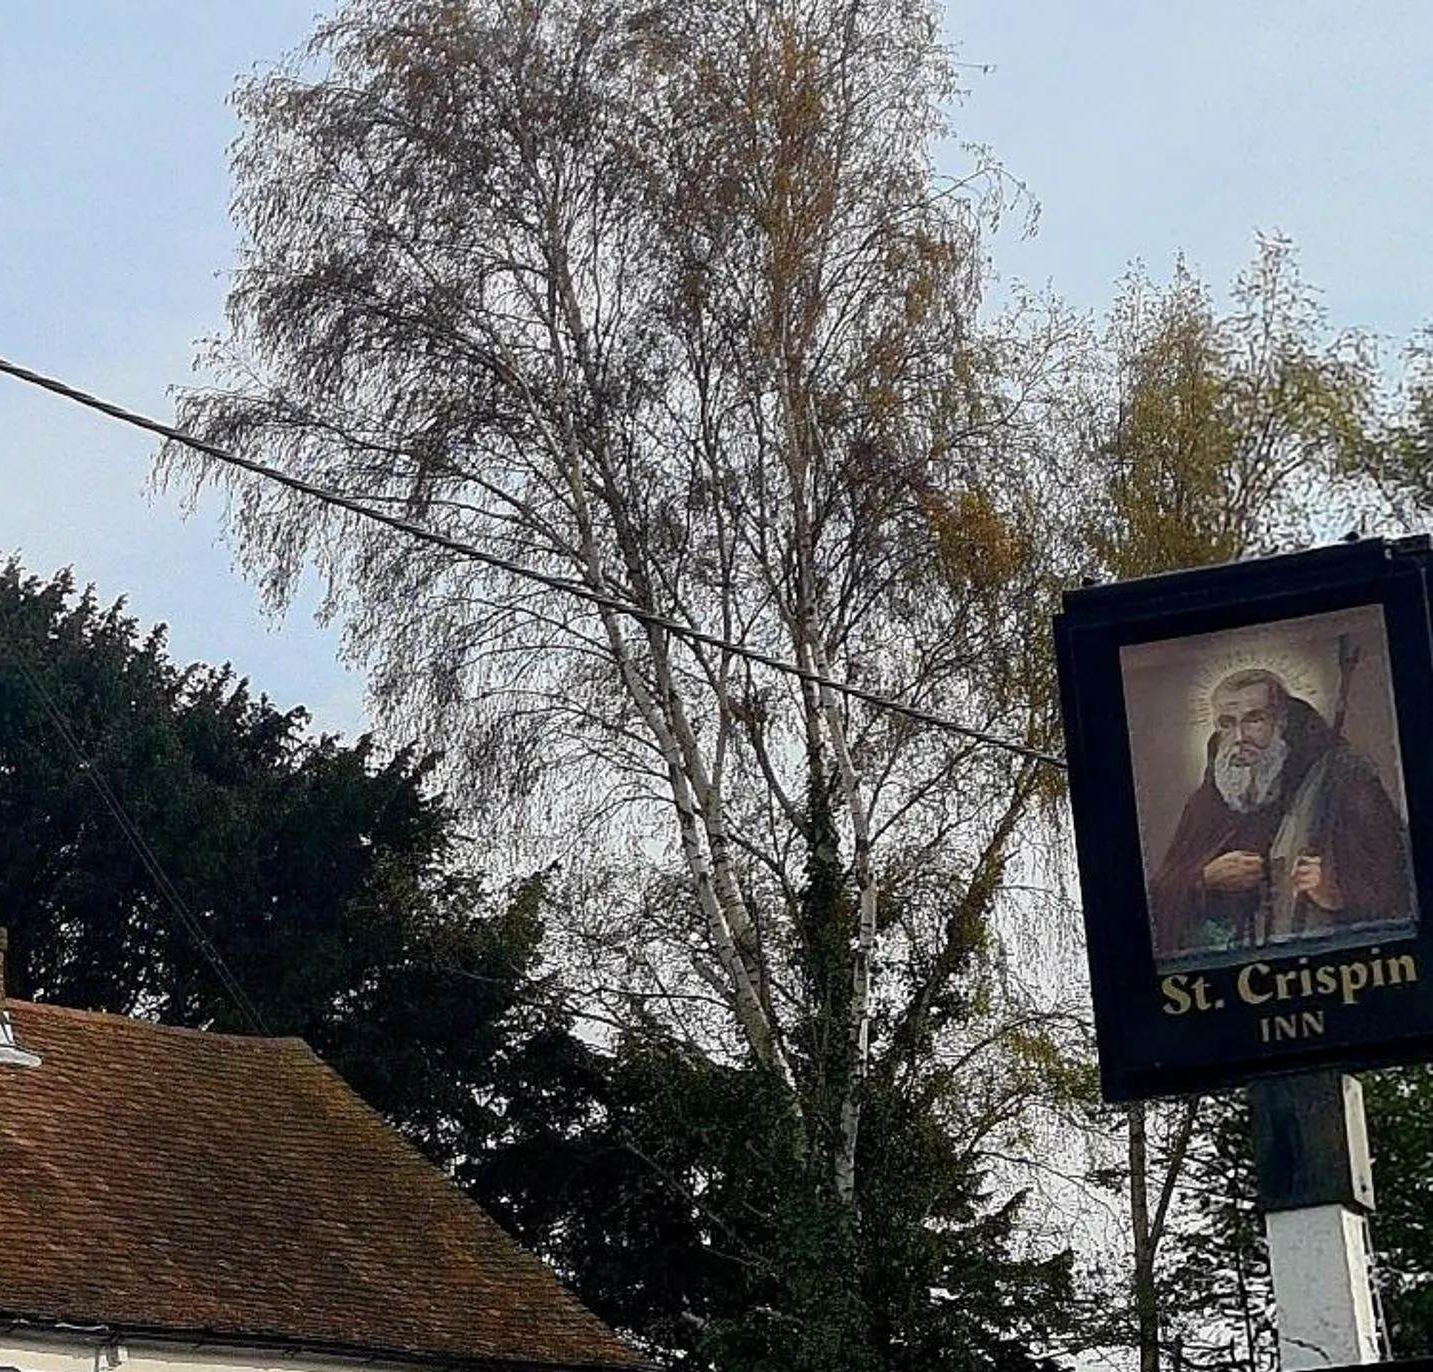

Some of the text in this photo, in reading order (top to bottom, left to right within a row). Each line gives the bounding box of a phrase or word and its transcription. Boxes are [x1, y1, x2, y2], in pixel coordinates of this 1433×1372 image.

[1161, 947, 1417, 1015] St. Crispin
[1260, 1010, 1325, 1042] INN
